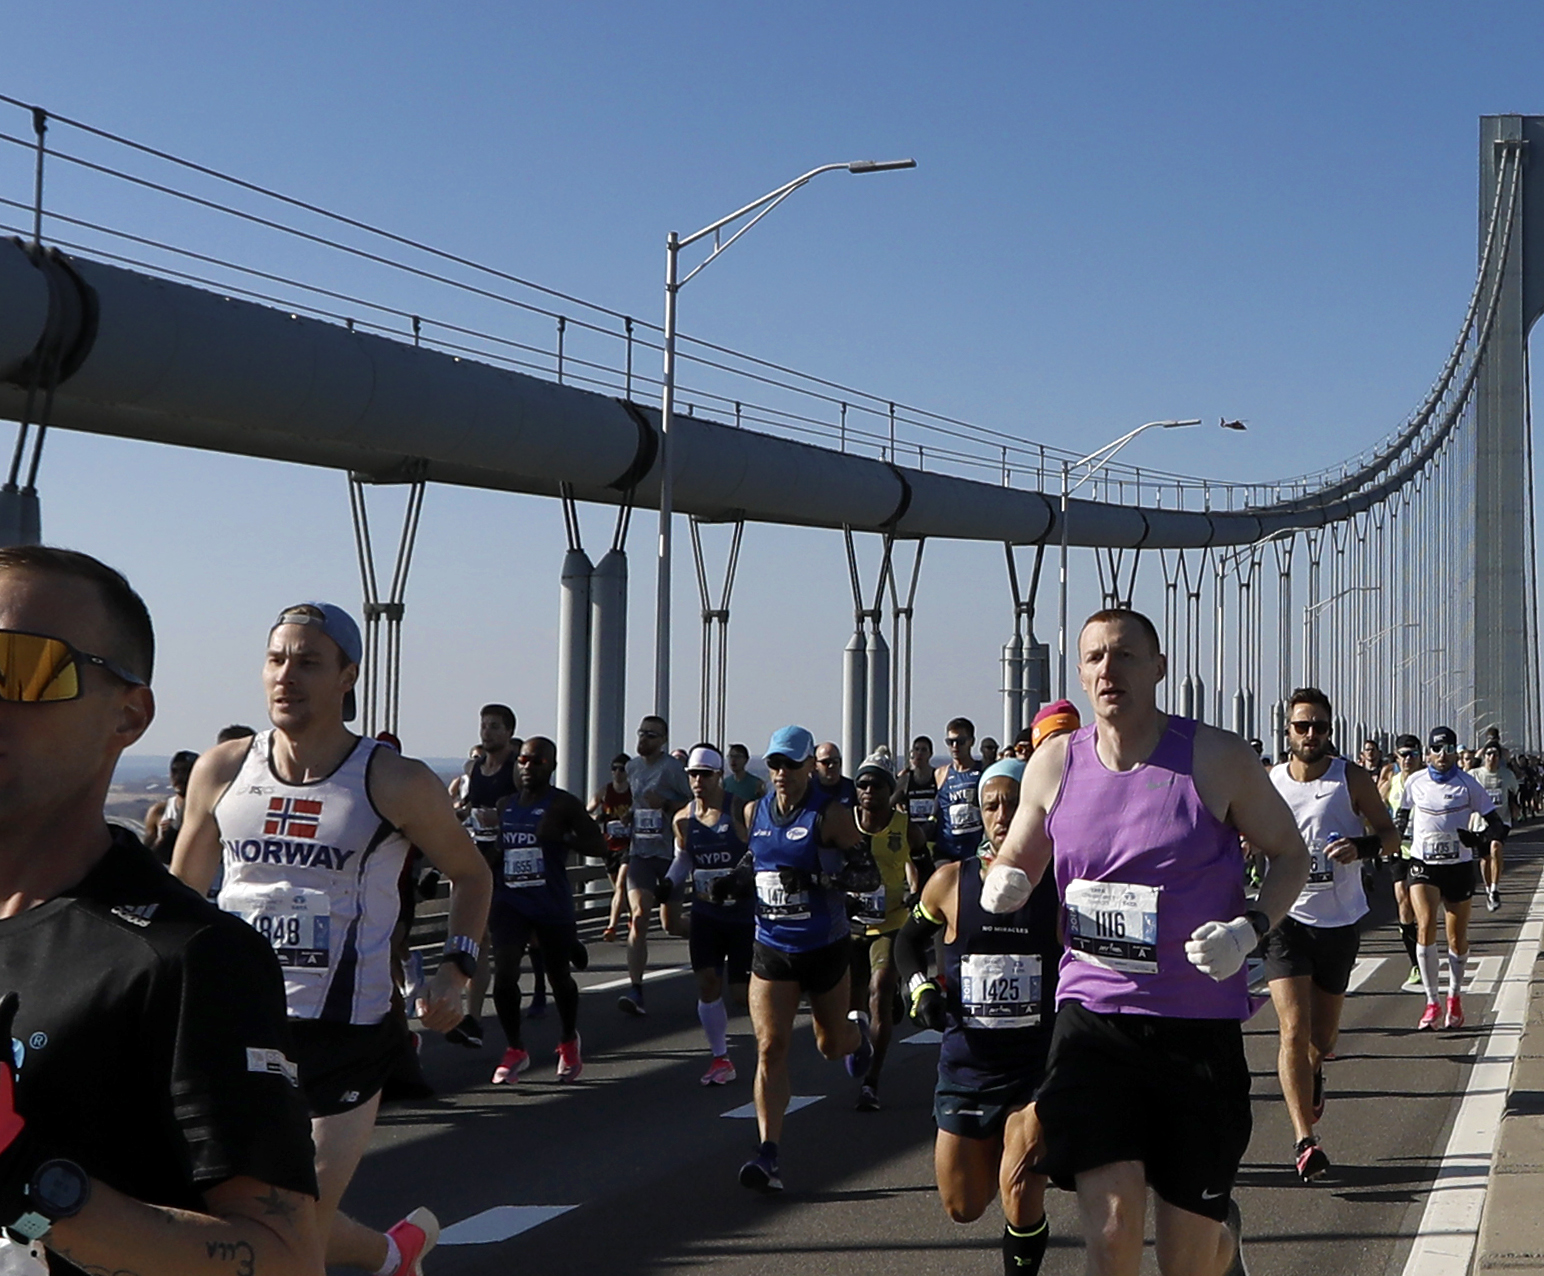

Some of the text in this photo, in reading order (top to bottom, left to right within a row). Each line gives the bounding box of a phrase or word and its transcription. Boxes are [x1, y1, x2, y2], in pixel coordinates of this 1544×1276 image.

[503, 832, 537, 845] NYPD
[227, 839, 355, 872] NORWAY
[695, 851, 732, 865] NYPD
[253, 915, 300, 946] 848
[994, 926, 1029, 934] MIRACLES
[1095, 911, 1126, 939] 1116
[308, 955, 317, 964] A
[1138, 949, 1146, 958] A
[983, 977, 1020, 1001] 1425
